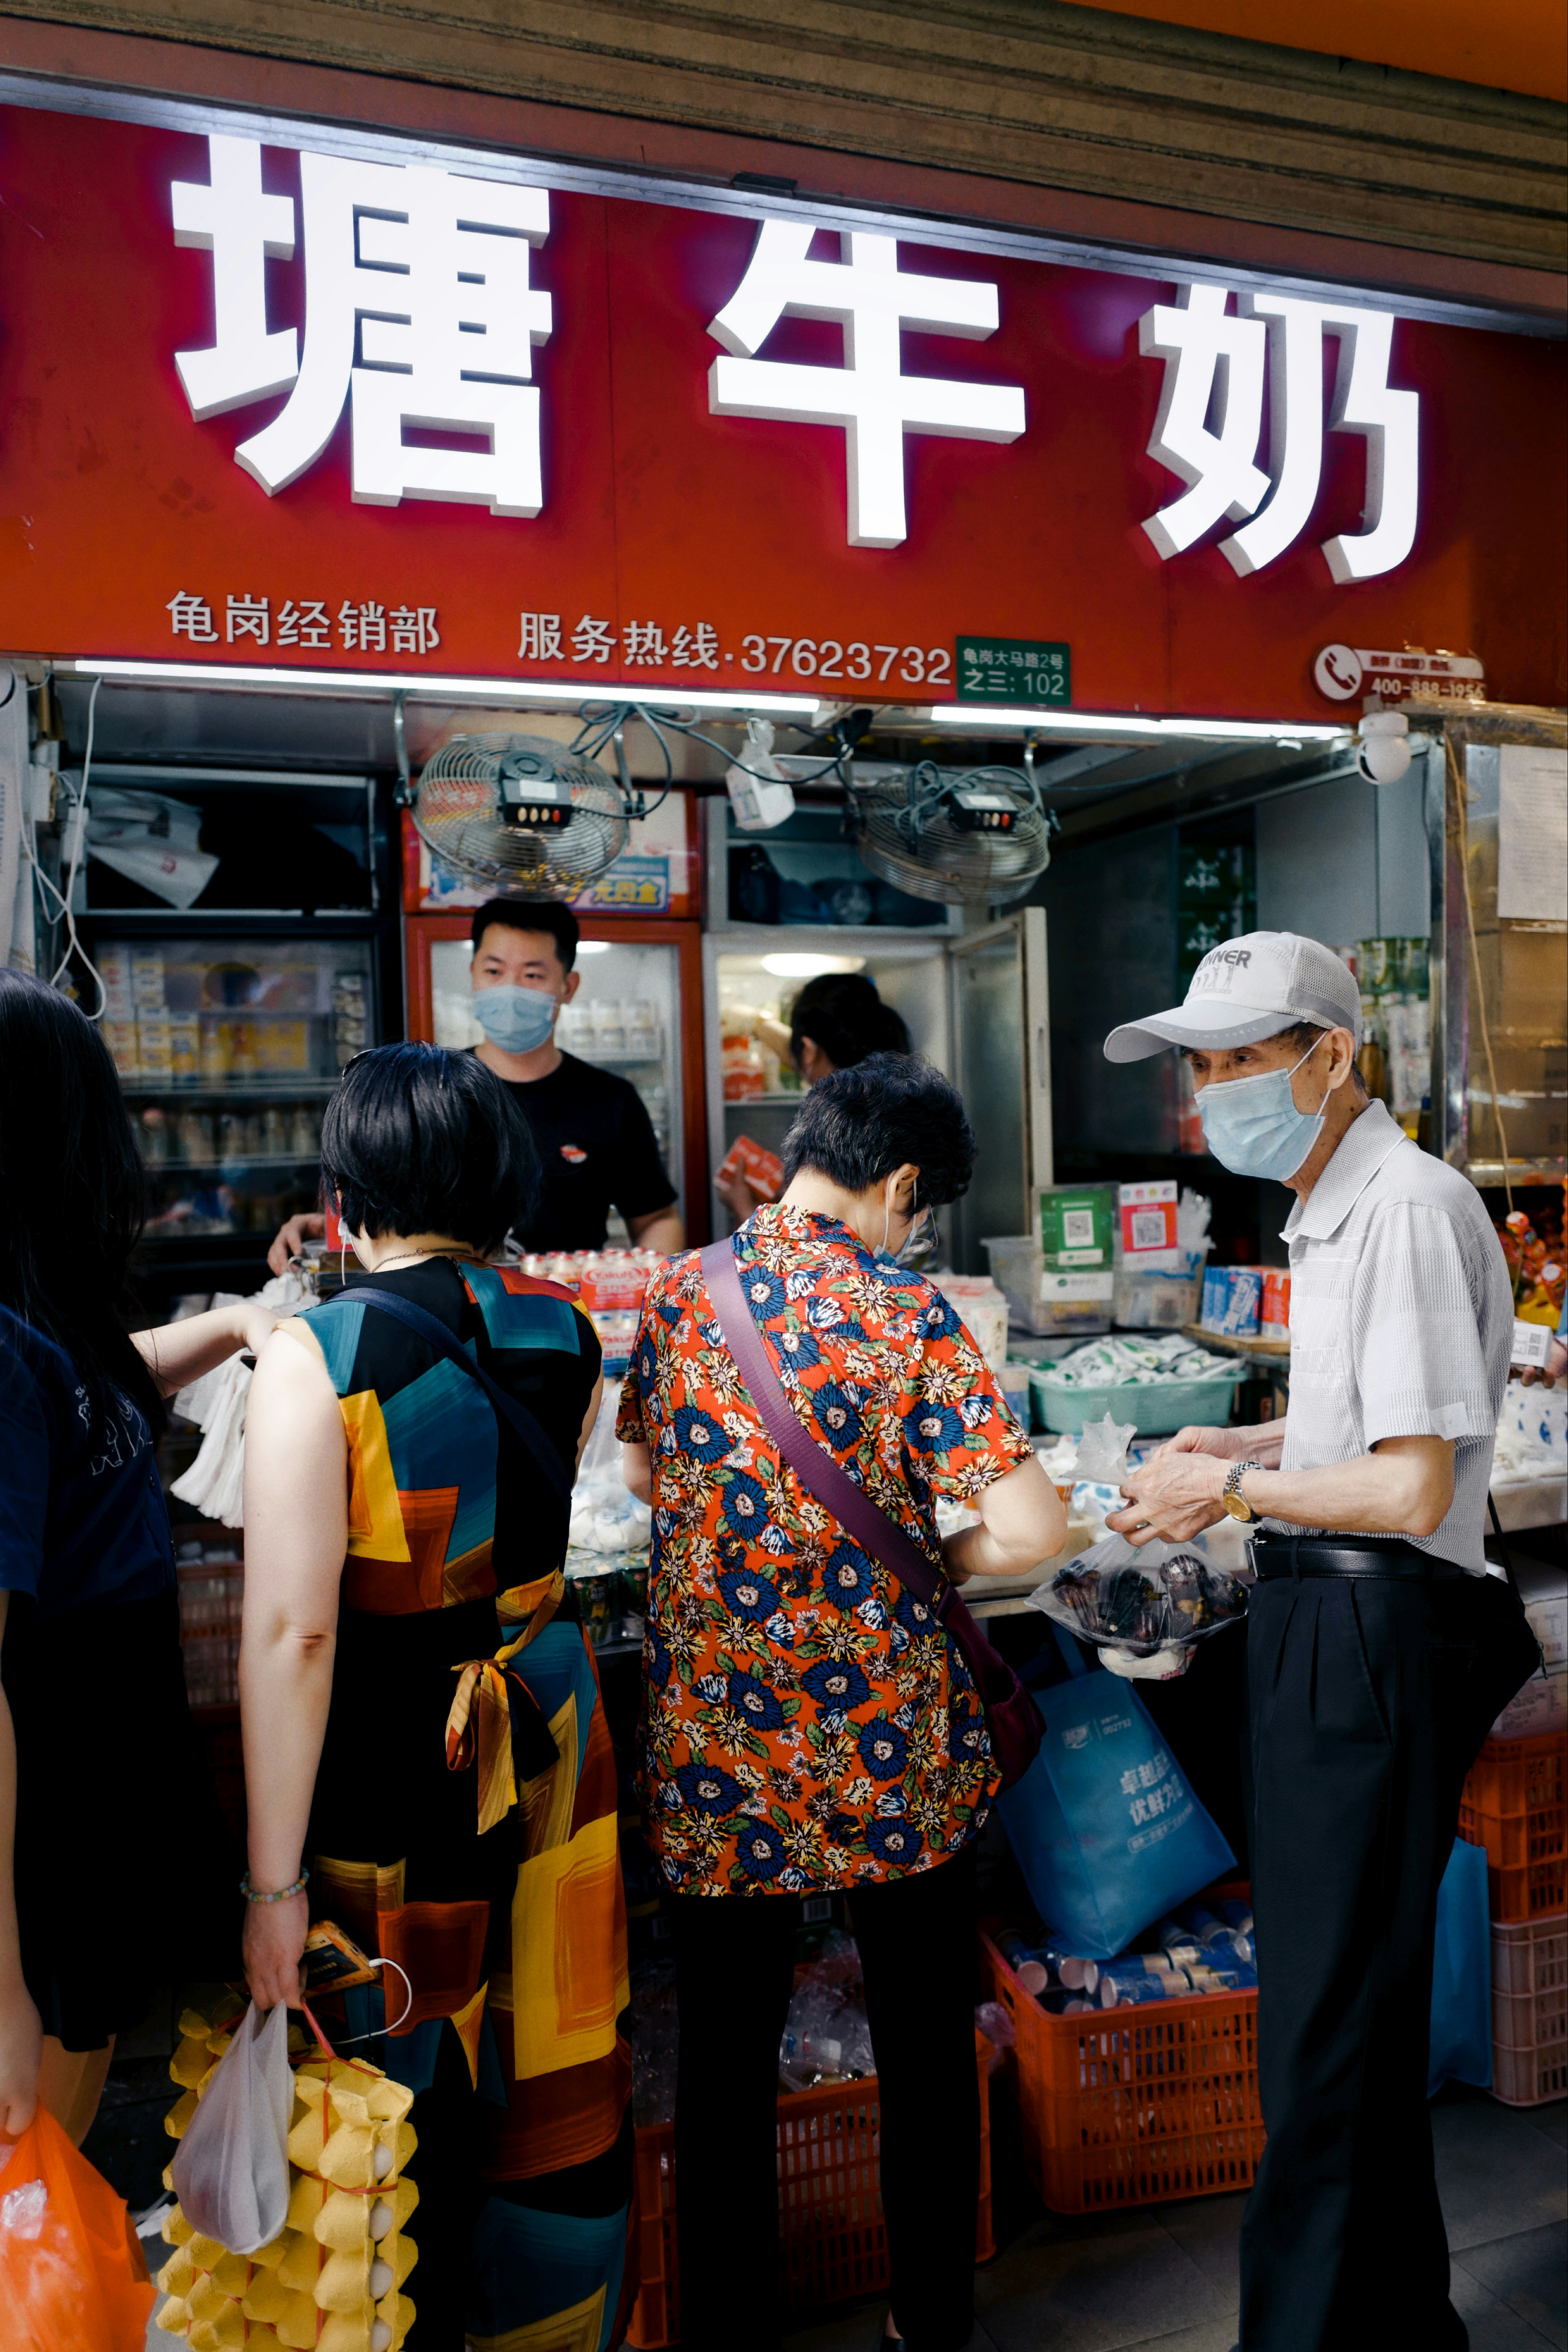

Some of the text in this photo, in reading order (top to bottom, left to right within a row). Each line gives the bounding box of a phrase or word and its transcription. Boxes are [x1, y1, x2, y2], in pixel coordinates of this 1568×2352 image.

[165, 590, 440, 654] 龟岗经销部
[964, 648, 1064, 670] 龟岗大马路2号
[1195, 950, 1252, 970] UNNER
